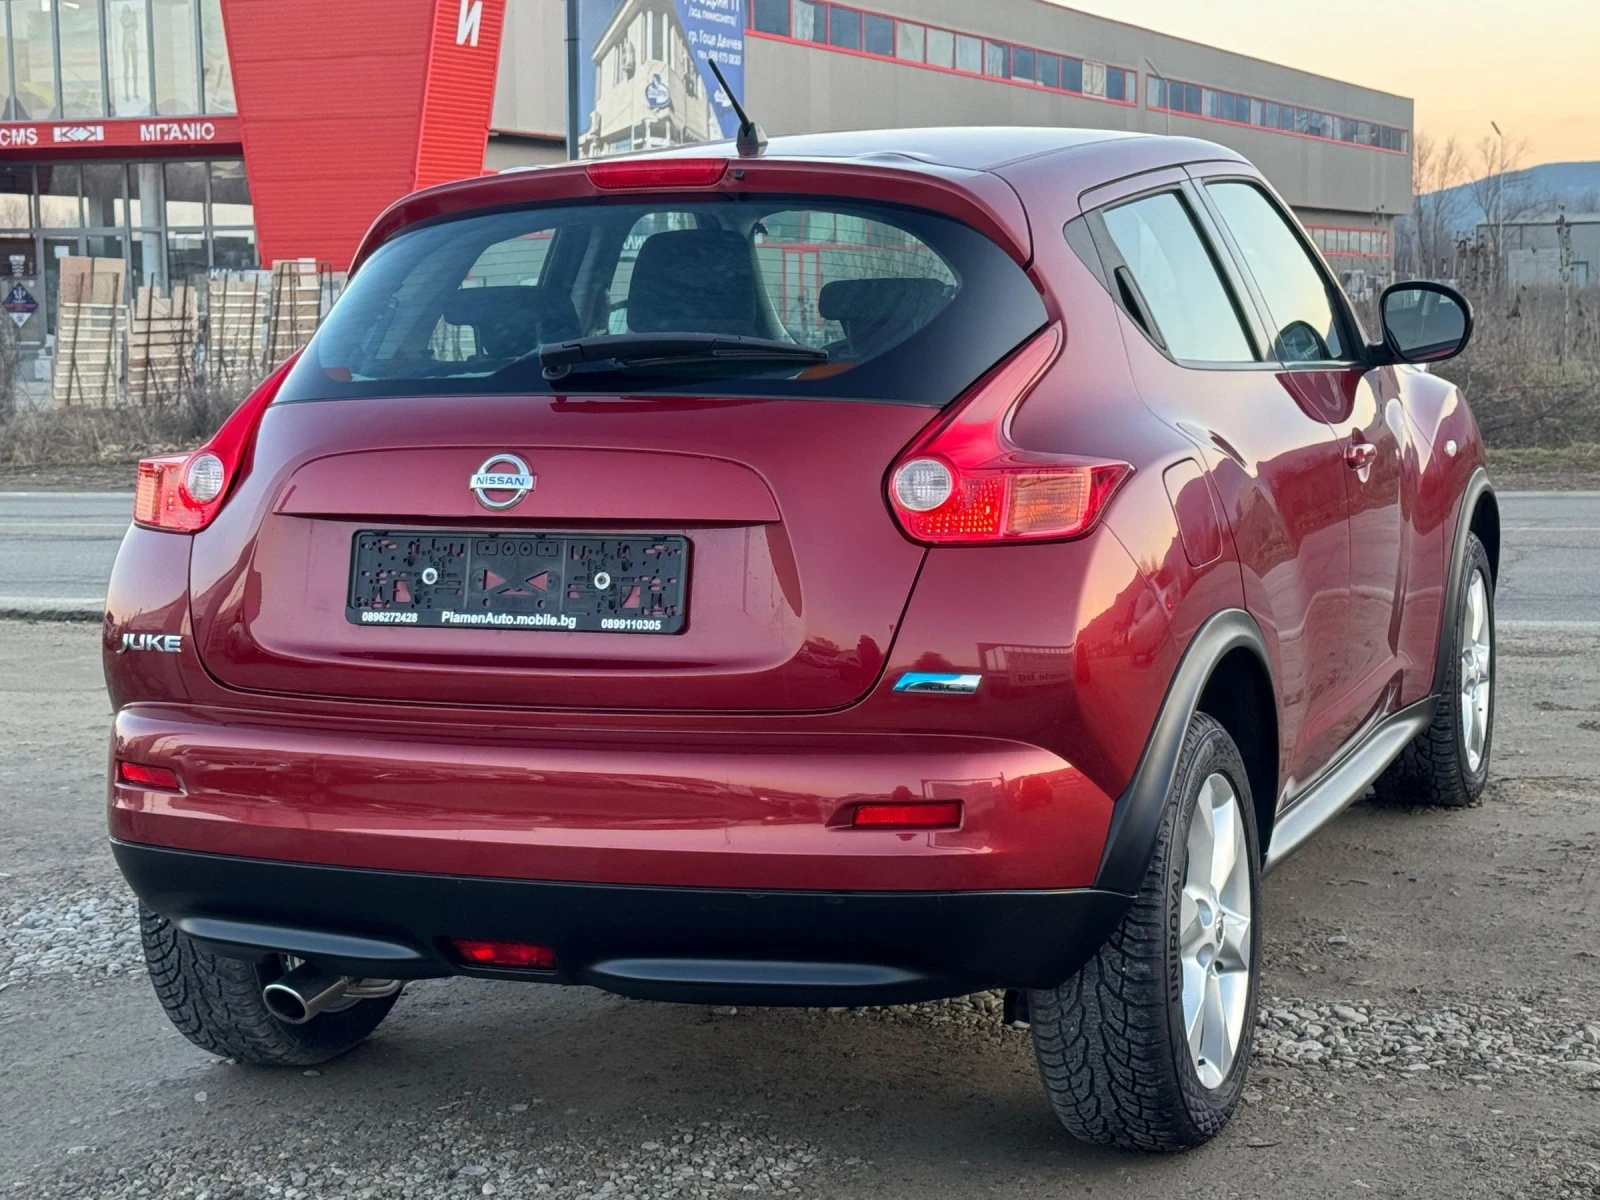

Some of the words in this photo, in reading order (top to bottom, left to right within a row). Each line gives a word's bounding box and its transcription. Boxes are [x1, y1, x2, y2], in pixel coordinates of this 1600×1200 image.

[476, 476, 525, 486] NISSAN
[361, 611, 418, 623] 0896272428
[441, 611, 577, 629] PlamenAuto.mobile.bg
[600, 618, 662, 631] 0899110305
[116, 633, 183, 655] JUKE
[1169, 868, 1182, 1003] UNIROYAL
